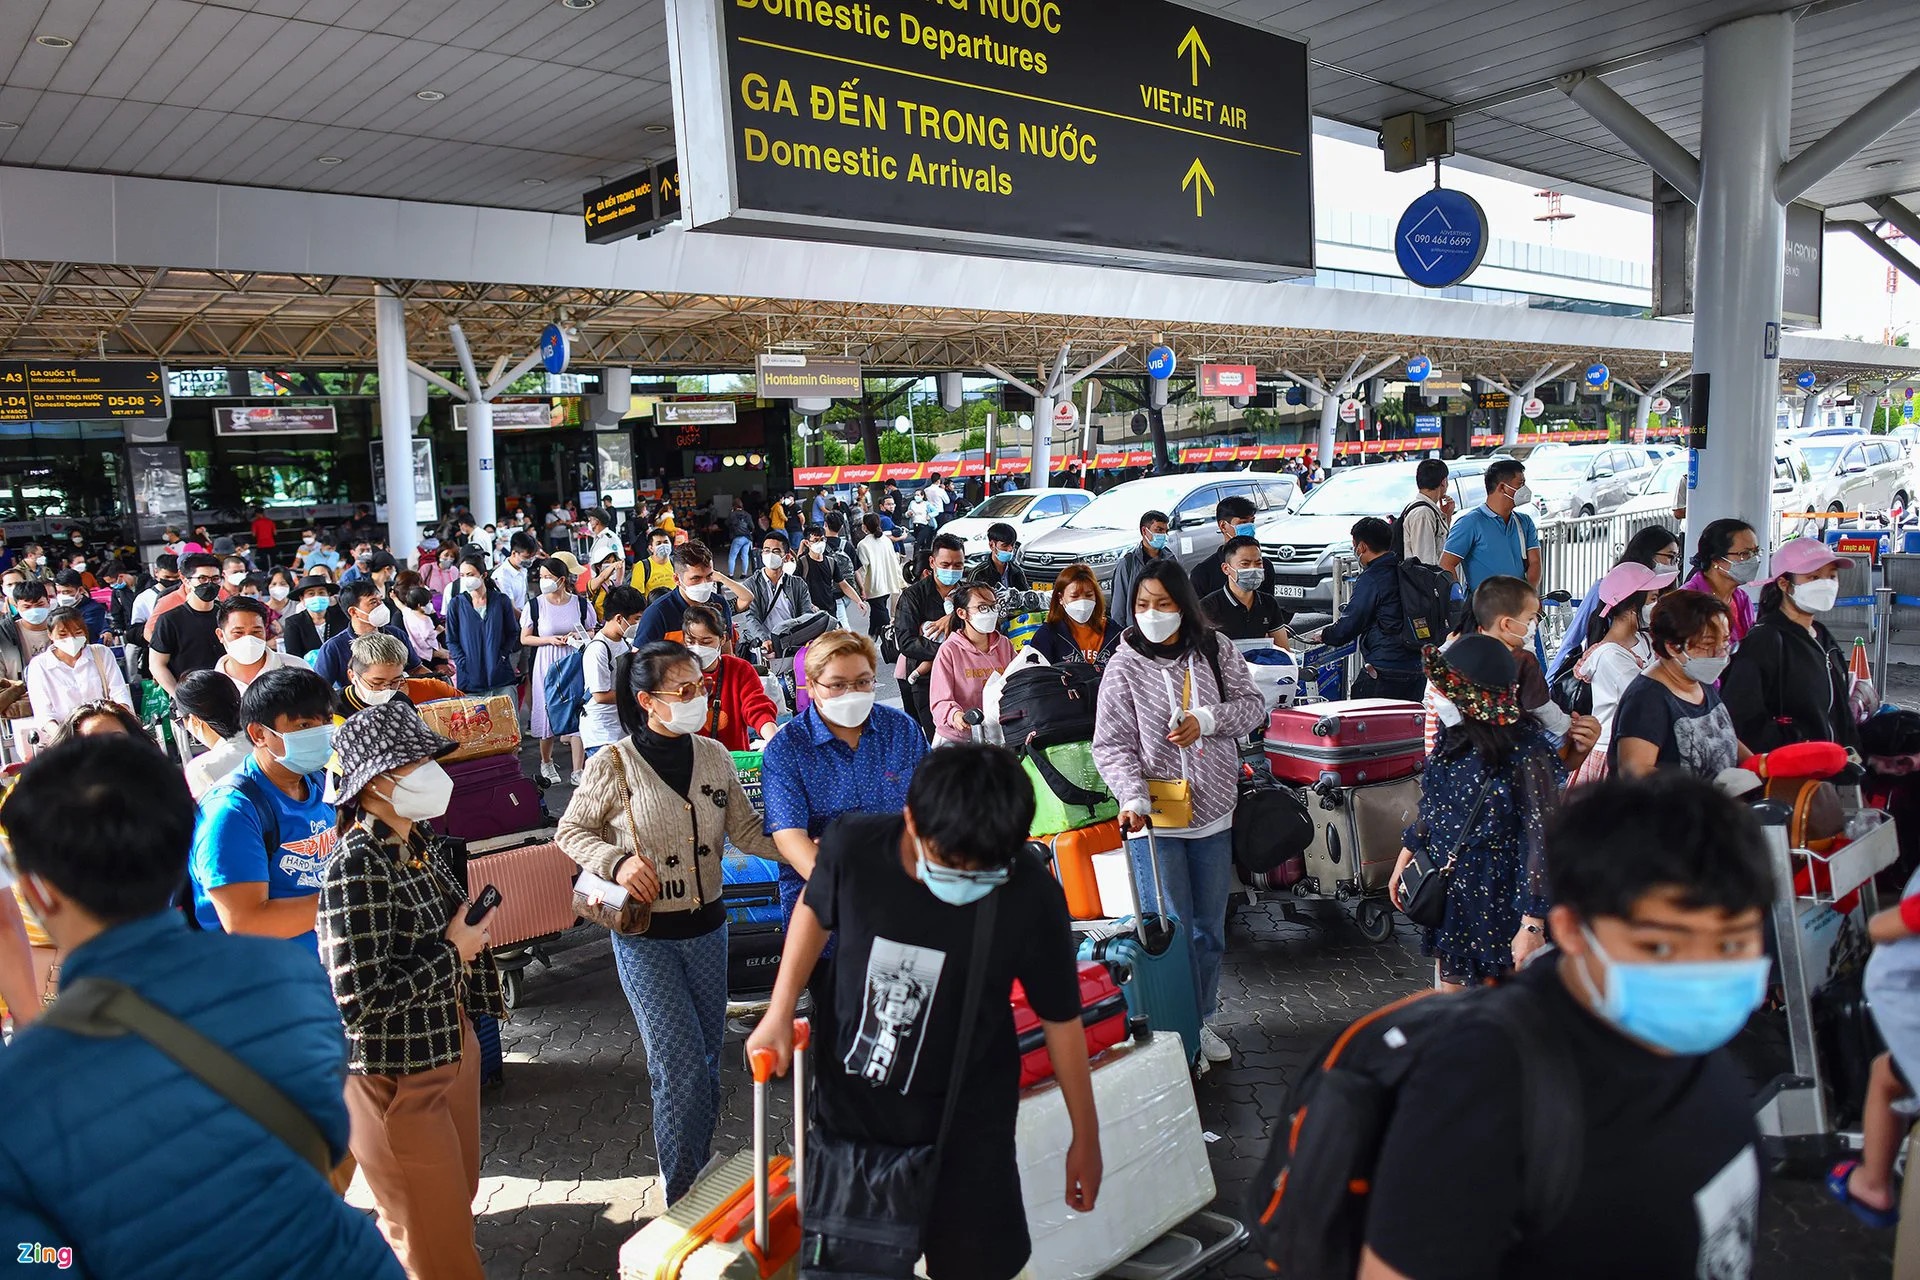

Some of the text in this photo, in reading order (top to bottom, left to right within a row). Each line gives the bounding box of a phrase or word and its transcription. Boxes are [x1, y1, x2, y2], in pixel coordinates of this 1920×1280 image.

[736, 0, 1048, 75] omestic Departures
[1140, 84, 1247, 130] VIETJET AIR
[741, 73, 1097, 165] GA ĐẾN TRONG NƯỚC
[744, 128, 1013, 195] Domestic Arrivals
[616, 189, 635, 204] TRONG
[1414, 234, 1471, 247] 090 464 6699
[1148, 359, 1164, 370] VIB
[1408, 365, 1421, 374] VIB
[765, 373, 859, 388] Homtamin Ginseng
[108, 396, 145, 406] D5-D8
[287, 856, 310, 870] HARD
